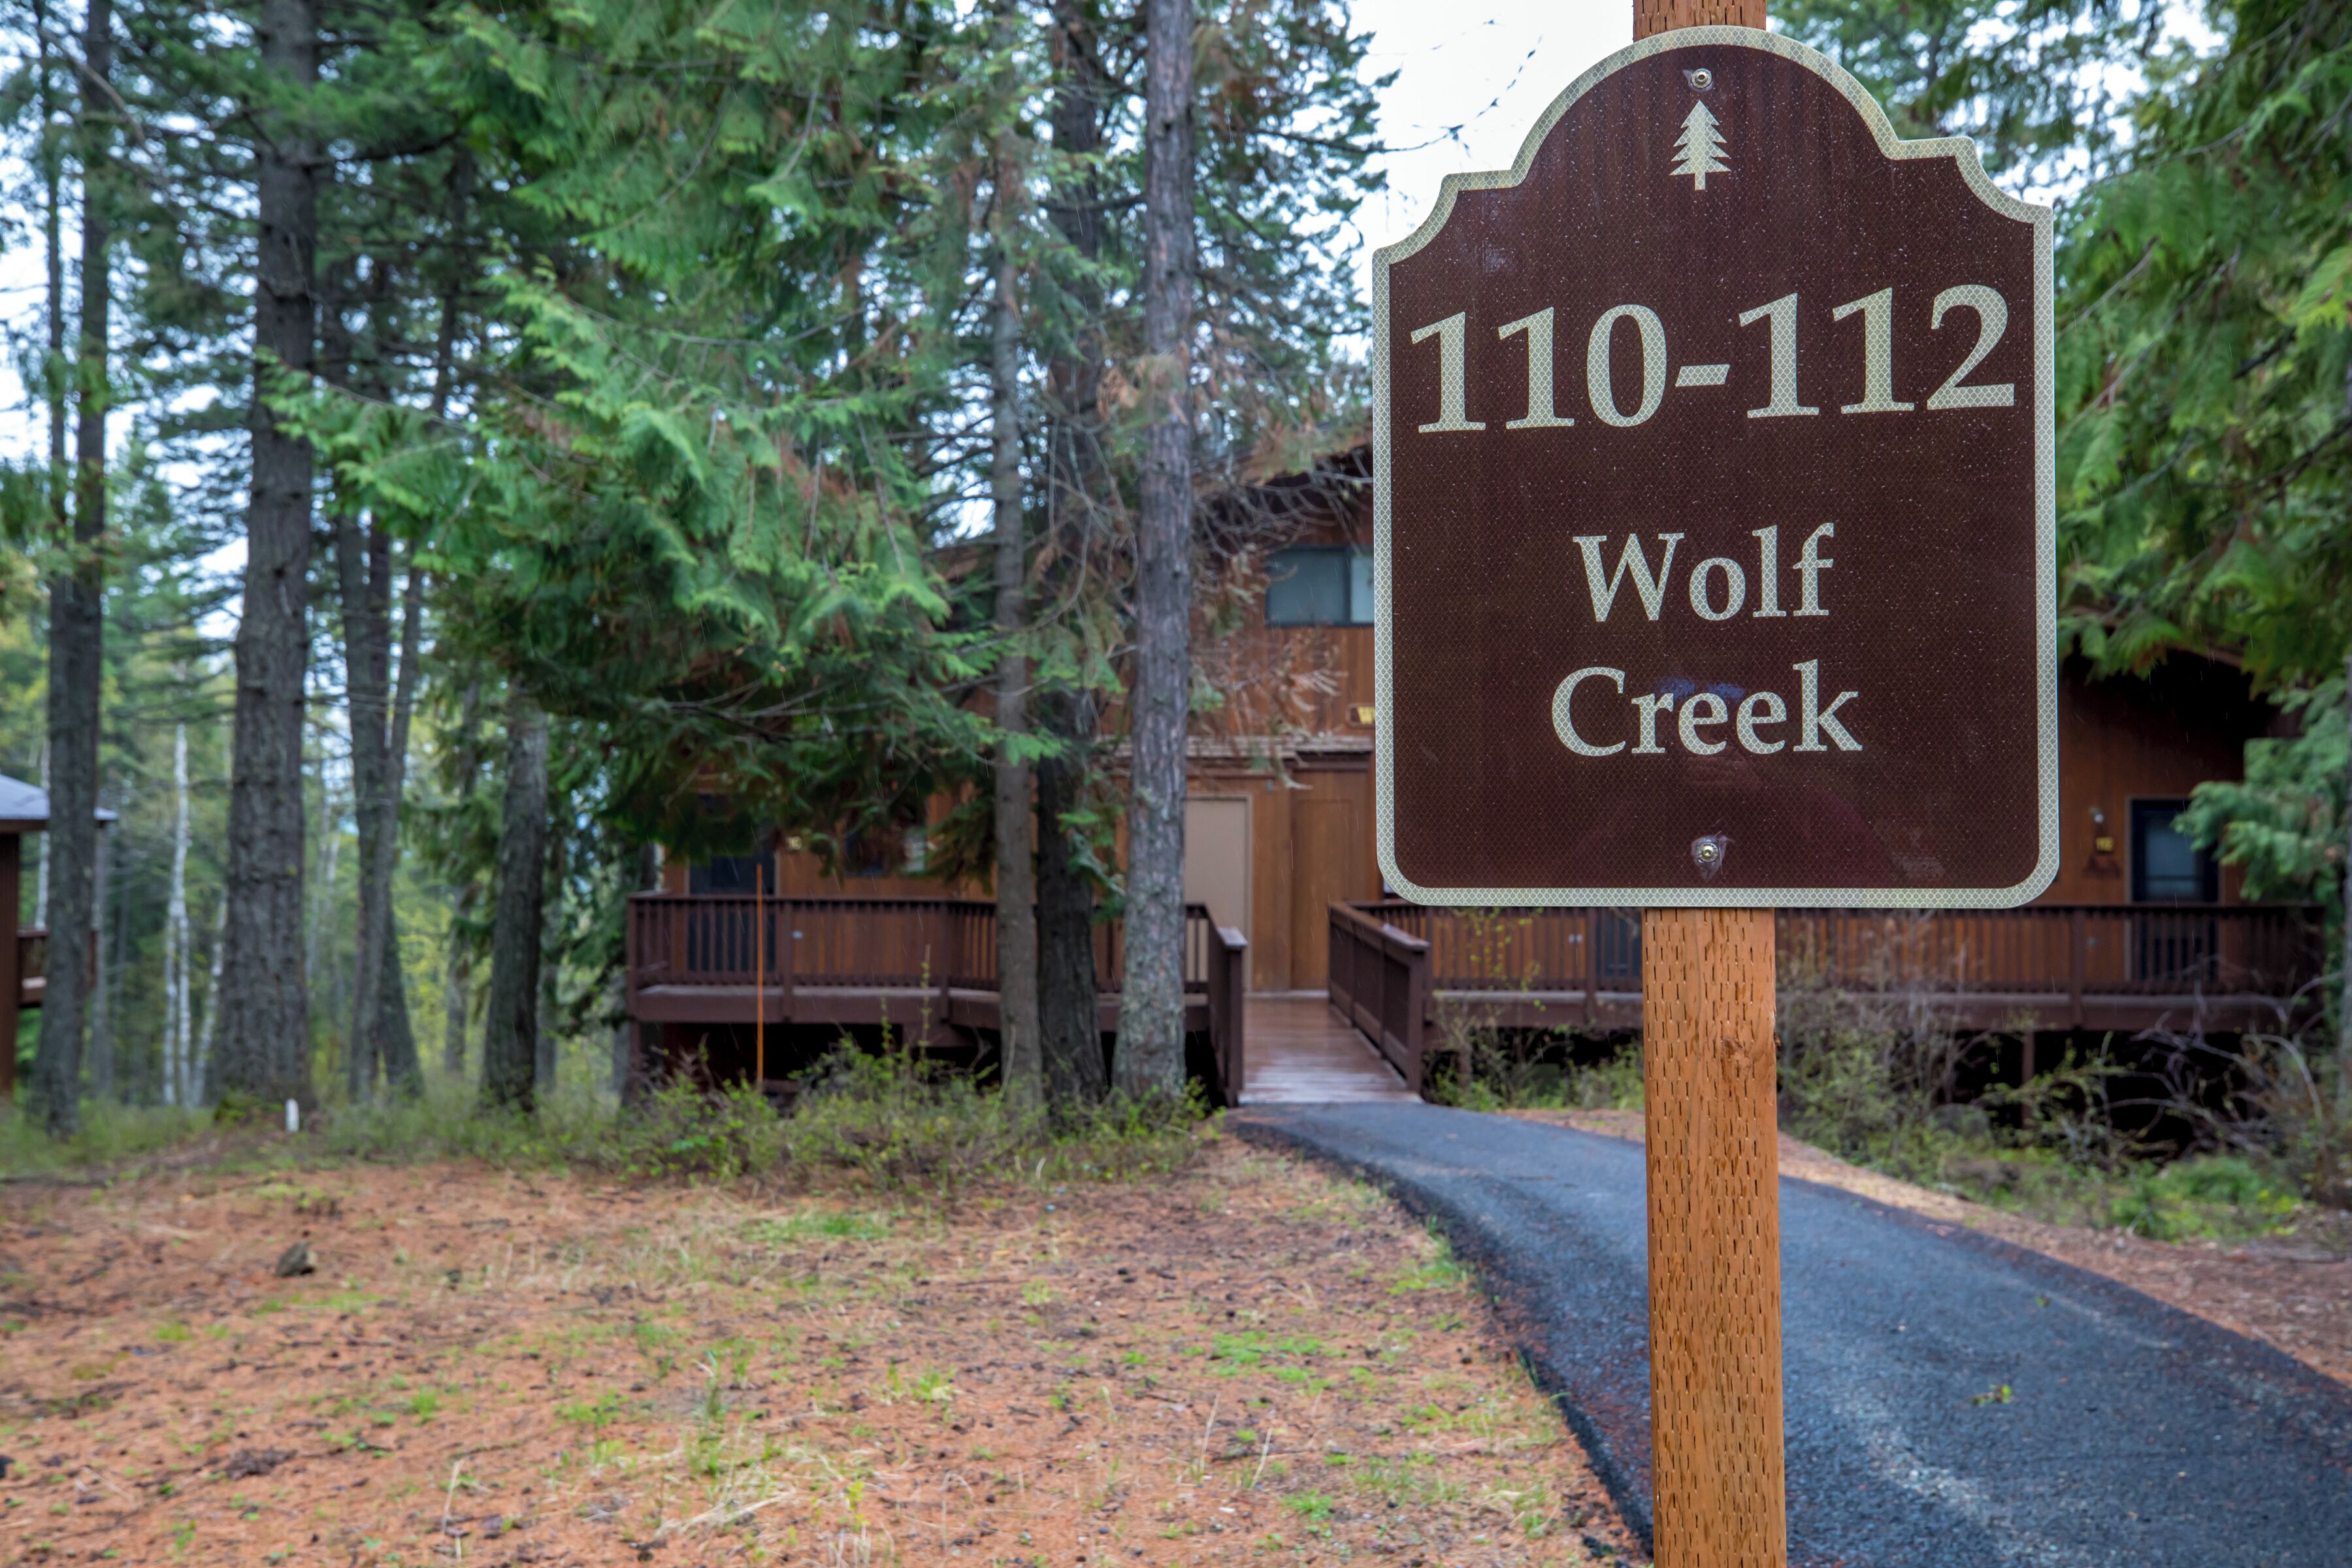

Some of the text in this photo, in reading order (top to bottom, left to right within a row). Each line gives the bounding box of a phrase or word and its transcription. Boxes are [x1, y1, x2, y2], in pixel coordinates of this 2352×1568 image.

[1411, 284, 2016, 434] 110-112
[1572, 522, 1835, 623] Wolf
[1551, 659, 1863, 757] Creek
